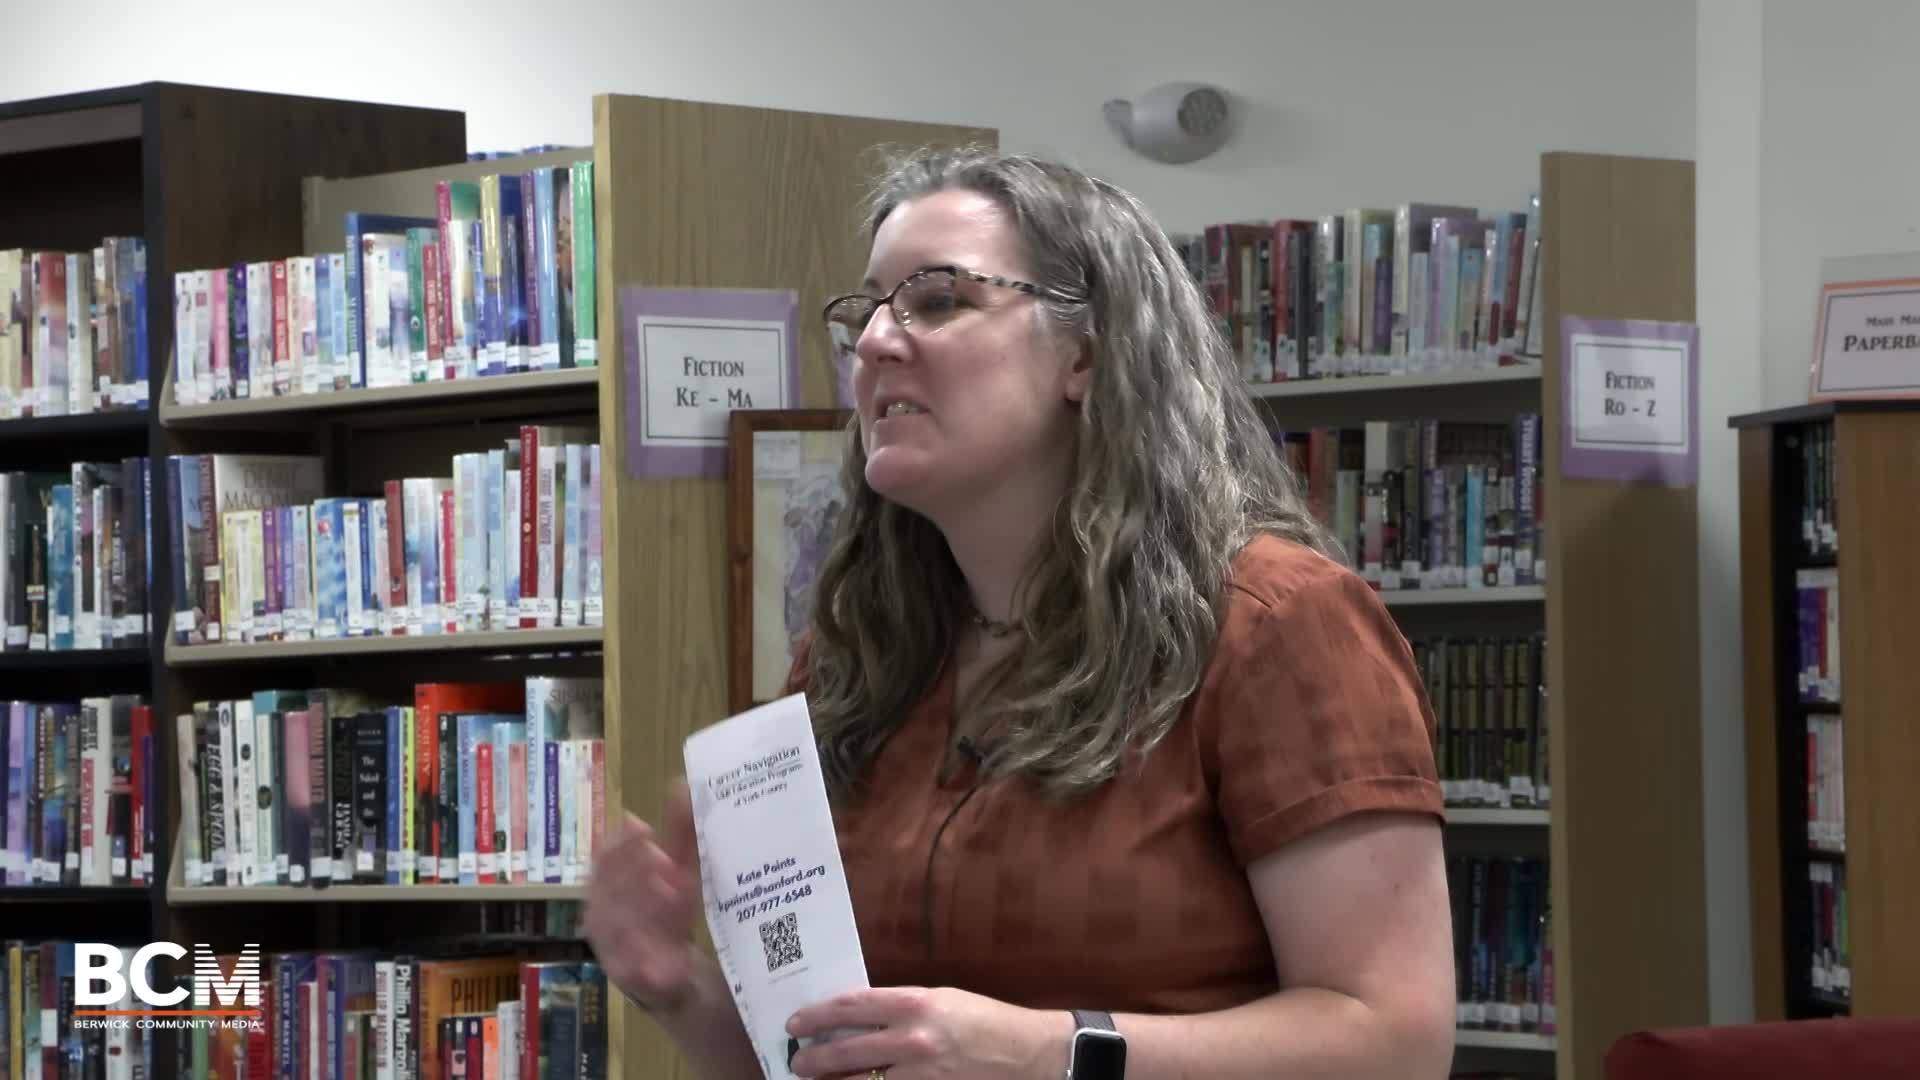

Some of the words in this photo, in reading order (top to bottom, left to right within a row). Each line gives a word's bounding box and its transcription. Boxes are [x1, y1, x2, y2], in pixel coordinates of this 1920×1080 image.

[743, 744, 800, 773] Navigation
[736, 869, 762, 886] Kate
[763, 856, 797, 876] Points
[736, 884, 813, 923] 207-977-6548
